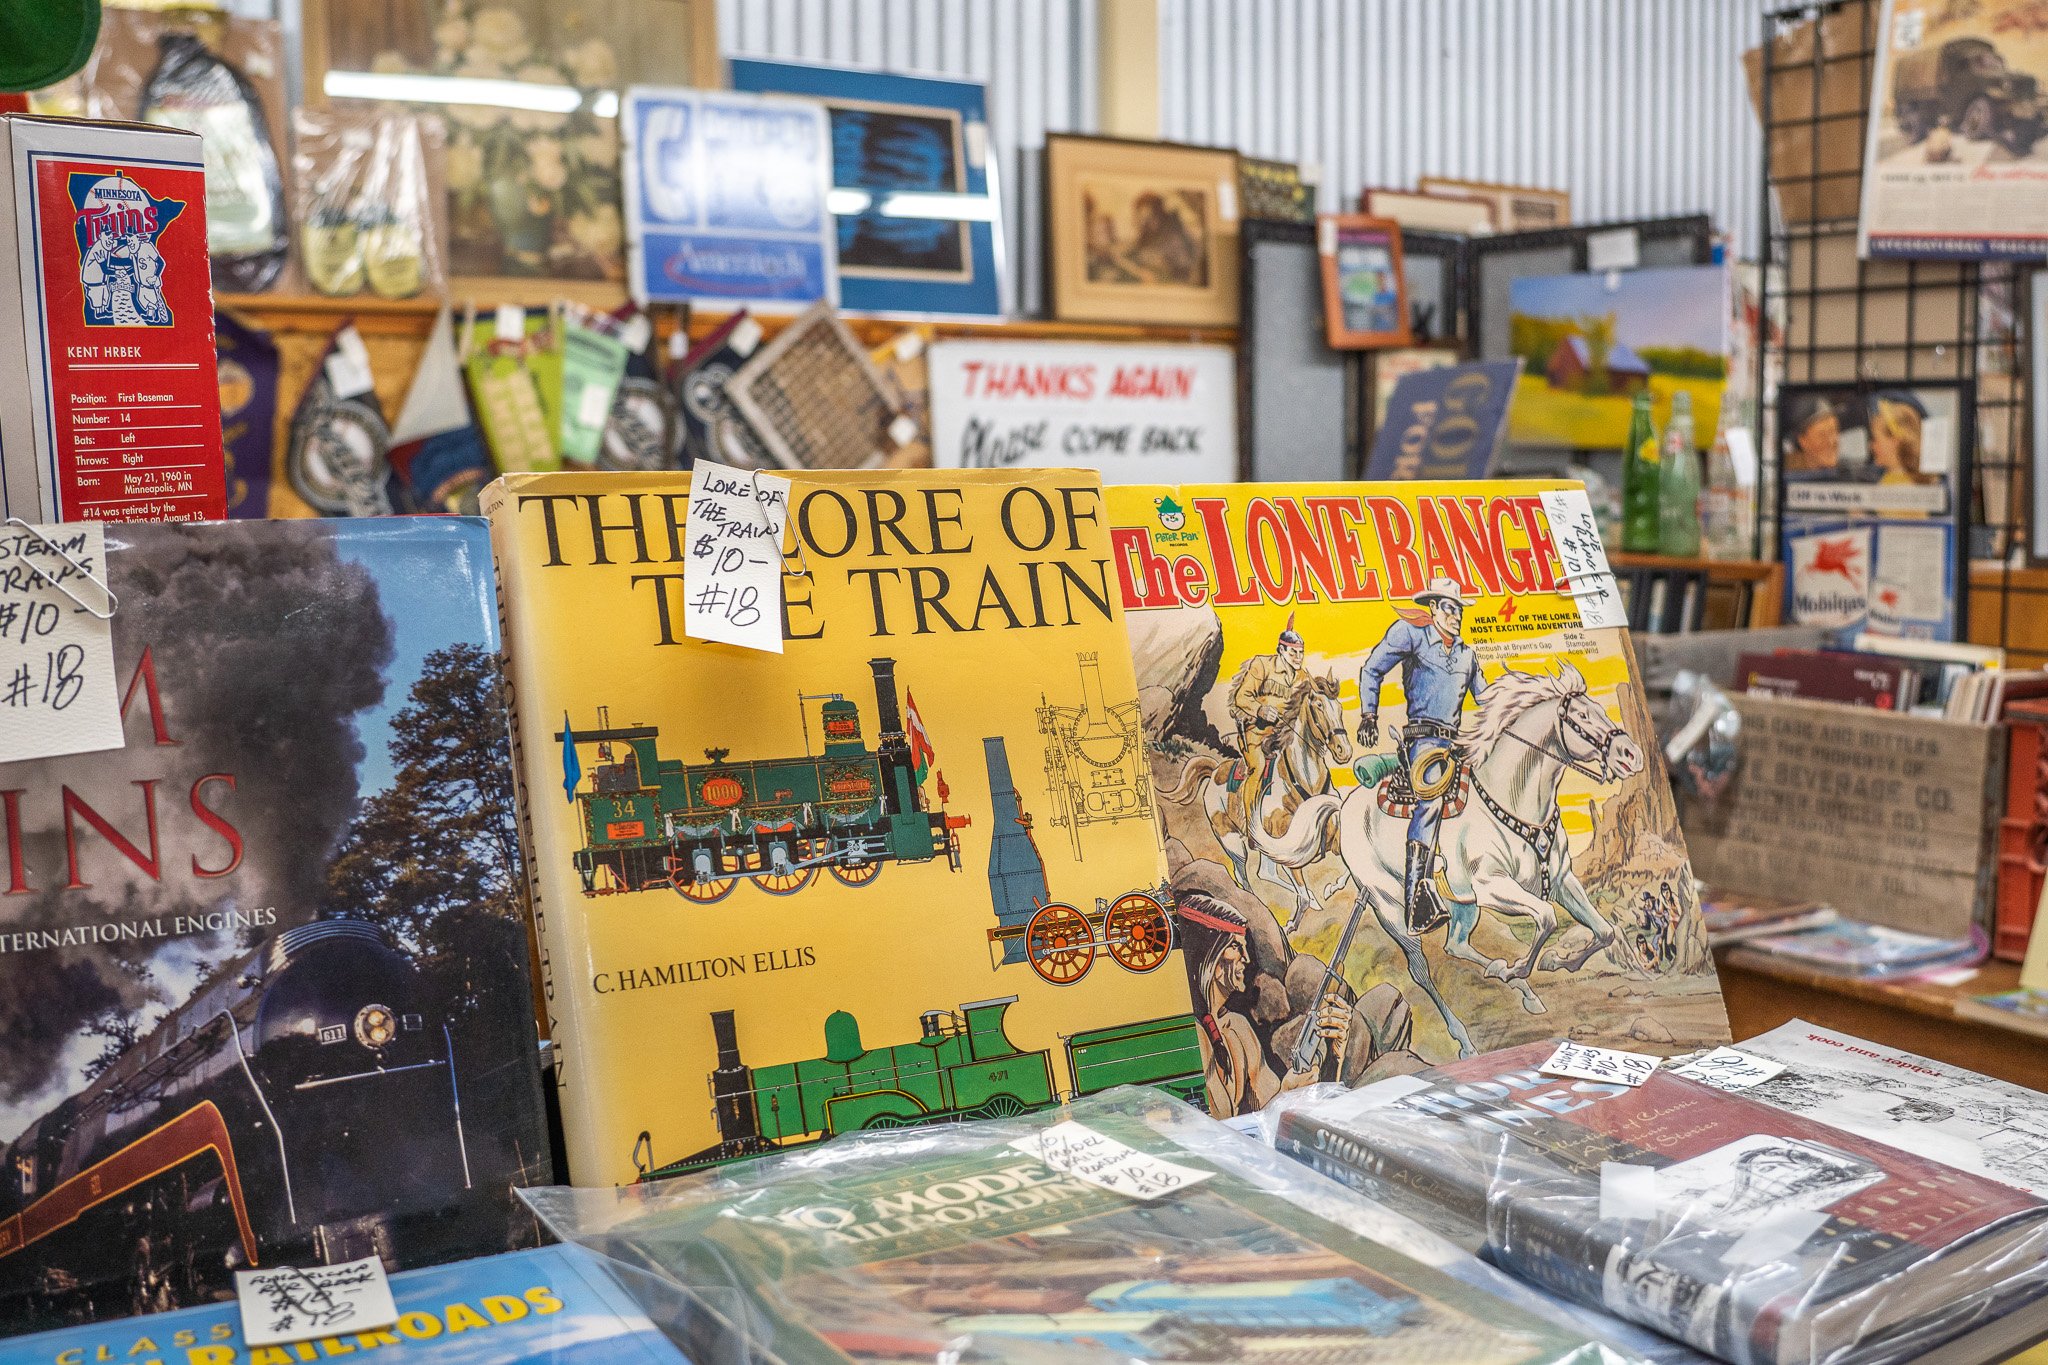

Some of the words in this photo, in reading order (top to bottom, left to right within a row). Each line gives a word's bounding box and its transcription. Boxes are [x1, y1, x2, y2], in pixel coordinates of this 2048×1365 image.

[94, 188, 142, 201] MINNESOTA
[76, 203, 158, 247] Twins
[67, 346, 98, 358] KENT
[104, 346, 142, 358] HRBEK
[961, 362, 1097, 399] THANKS
[1107, 365, 1197, 399] AGAIN
[71, 393, 107, 404] Position:
[118, 393, 135, 402] First
[137, 392, 174, 402] Baseman
[72, 413, 110, 424] Number:
[120, 413, 131, 423] 14
[74, 435, 96, 445] Bats:
[121, 433, 136, 443] Left
[1060, 424, 1133, 456] COME
[1140, 424, 1204, 456] BACK
[75, 455, 109, 466] Throws:
[122, 453, 144, 466] Right
[77, 477, 100, 487] Born:
[124, 474, 143, 486] May
[144, 473, 158, 484] 21,
[161, 471, 182, 482] 1960
[183, 471, 191, 481] in
[124, 483, 176, 495] Minneapolis,
[177, 482, 193, 491] MN
[702, 472, 751, 498] LORE
[756, 490, 784, 507] OF
[83, 508, 100, 518] #14
[102, 507, 120, 516] was
[122, 504, 148, 515] retired
[150, 503, 161, 516] by
[163, 502, 176, 512] the
[163, 513, 191, 522] August
[193, 511, 206, 521] 13,
[692, 498, 728, 522] THE
[1001, 486, 1102, 552] OF
[716, 521, 780, 539] TRAIN
[1580, 512, 1602, 552] LONE
[0, 533, 87, 560] STEAM
[1110, 526, 1210, 613] The
[1192, 496, 1384, 608] LONE
[1365, 496, 1572, 601] RANGE
[1572, 524, 1610, 605] RANGER
[630, 570, 827, 647] TE
[847, 559, 1116, 637] TRAIN
[689, 582, 761, 627] #18
[1474, 616, 1498, 624] HEAR
[1498, 596, 1518, 623] 4
[1518, 614, 1530, 622] OF
[1532, 613, 1548, 621] THE
[1549, 613, 1571, 621] LONE
[1470, 625, 1495, 633] MOST
[1496, 623, 1535, 632] EXCITING
[1536, 621, 1584, 631] ADVENTURE
[1472, 637, 1488, 645] Side
[1563, 633, 1578, 641] Side
[1578, 632, 1586, 640] 2:
[1565, 640, 1597, 648] Stampede
[1475, 643, 1503, 651] Ambush
[1511, 642, 1538, 651] Bryant's
[1538, 642, 1553, 650] Gap
[1477, 652, 1495, 660] Rope
[1496, 651, 1519, 659] Justice
[1567, 648, 1584, 656] Aces
[1584, 647, 1600, 655] Wild
[2, 644, 85, 711] #18
[706, 784, 739, 801] 1000
[612, 800, 636, 818] 34
[174, 906, 278, 935] ENGINES
[593, 974, 616, 996] C.
[618, 955, 747, 993] HAMILTON
[753, 946, 817, 974] ELLIS
[323, 1028, 344, 1042] 611
[1806, 1032, 1844, 1050] cook
[1845, 1045, 1881, 1061] and
[1621, 1058, 1653, 1085] #18
[1882, 1054, 1943, 1079] rehder
[988, 1069, 1010, 1083] 471
[1636, 1099, 1699, 1122] Classic
[1656, 1121, 1719, 1147] Stories
[1313, 1128, 1386, 1176] SHORT
[1137, 1171, 1181, 1194] #18
[55, 1322, 235, 1365] CLASS
